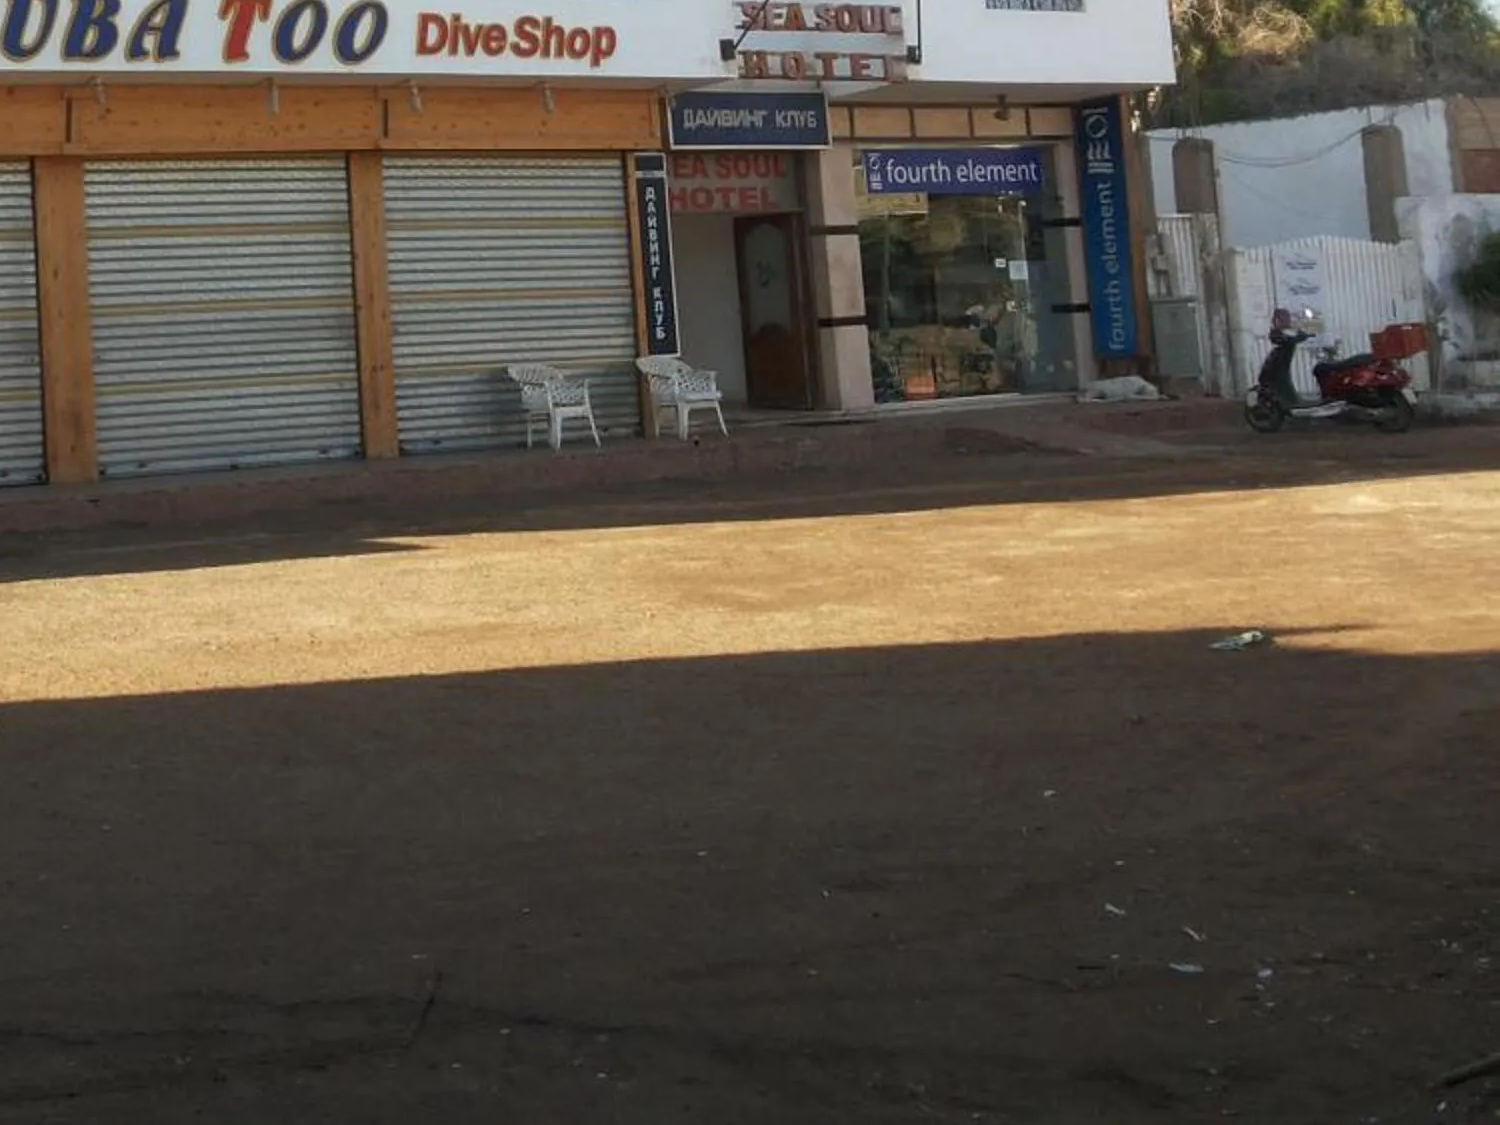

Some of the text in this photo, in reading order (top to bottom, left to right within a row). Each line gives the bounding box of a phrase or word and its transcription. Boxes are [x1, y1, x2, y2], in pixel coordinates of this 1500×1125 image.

[735, 1, 903, 35] SEA SOUL
[737, 50, 908, 81] HOTEL
[682, 107, 818, 129] ДАЙВИНГ КЛУБ
[670, 154, 786, 180] EA SOUL
[885, 158, 1039, 184] fourth element
[670, 186, 779, 213] HOTEL
[1096, 181, 1126, 349] fourth element
